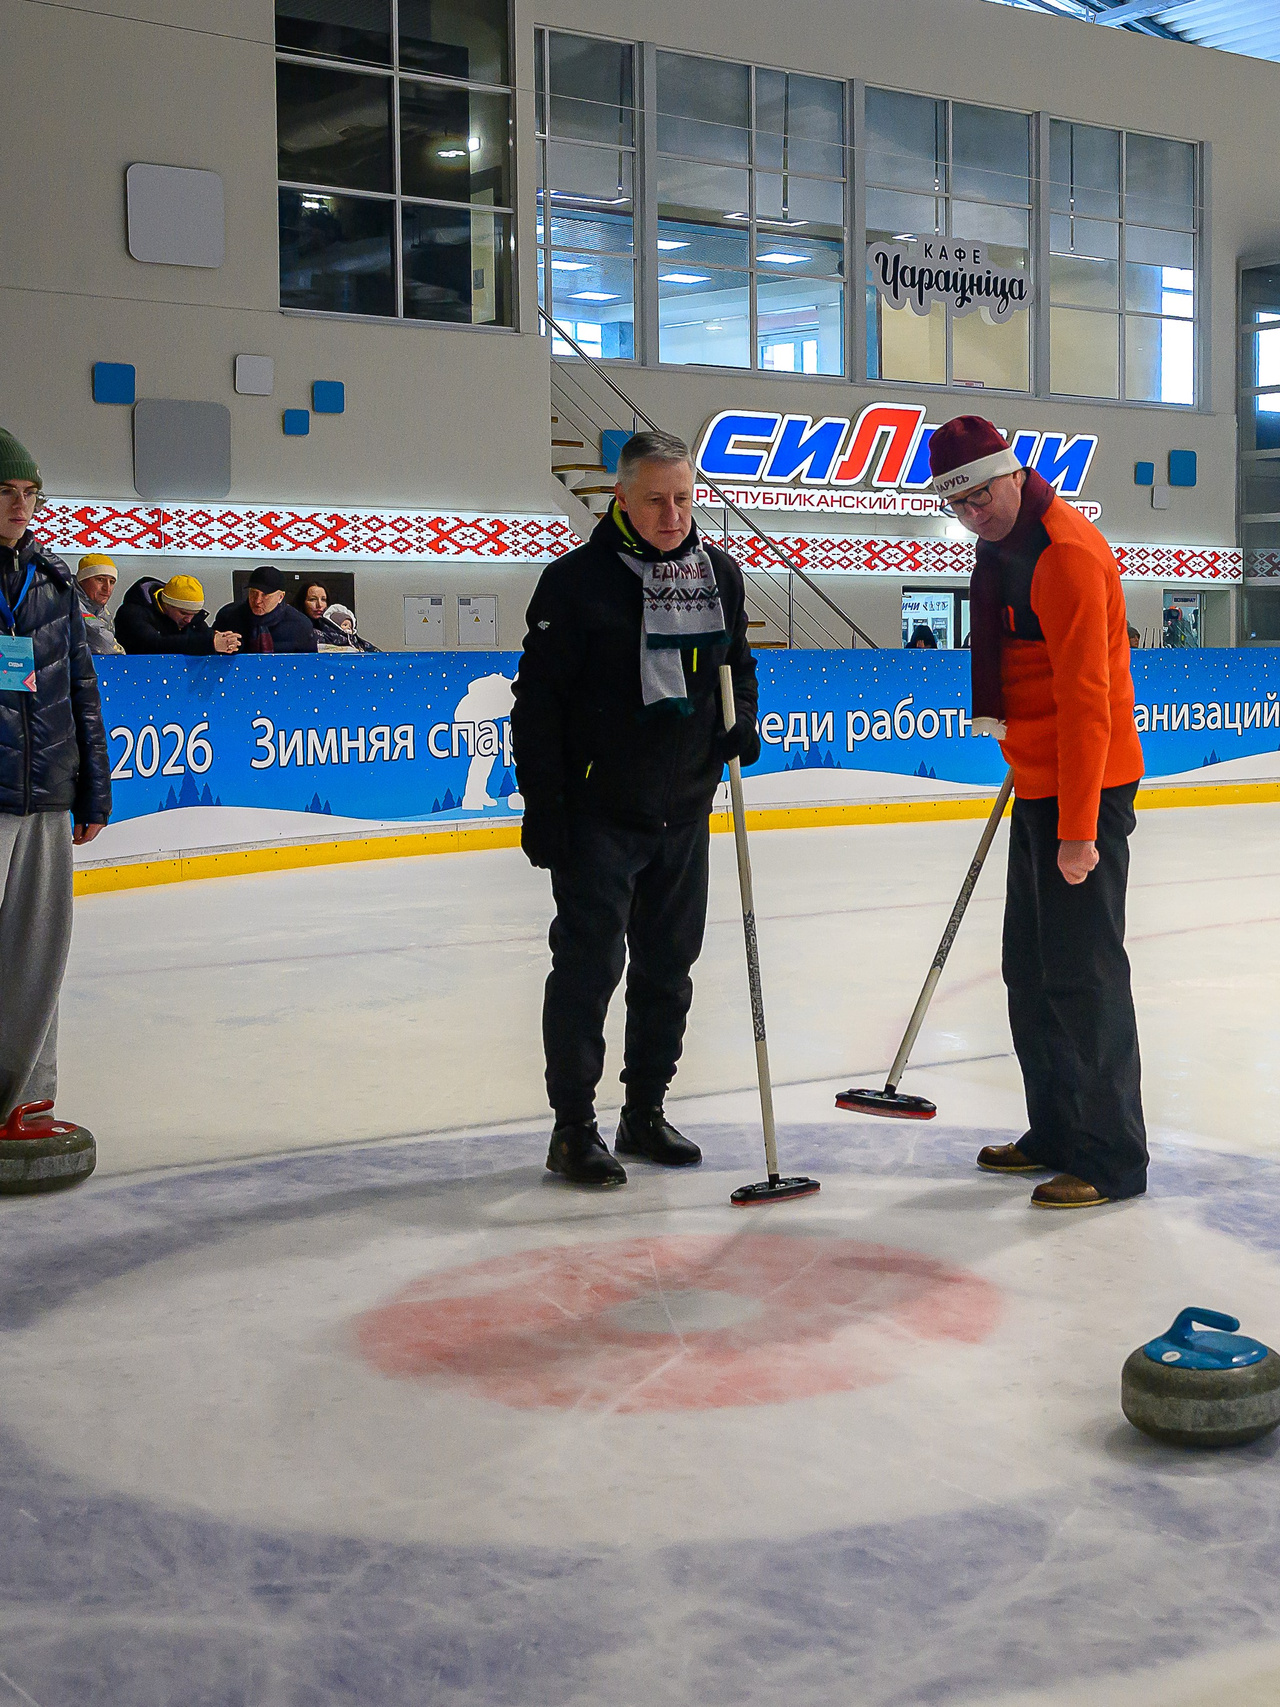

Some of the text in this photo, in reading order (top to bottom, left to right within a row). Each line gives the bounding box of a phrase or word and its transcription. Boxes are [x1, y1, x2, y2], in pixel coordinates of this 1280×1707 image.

[924, 243, 981, 265] КАФЕ
[874, 251, 1028, 315] Чараўніца
[698, 404, 1099, 497] СИЛИ
[695, 488, 898, 510] РЕСПУБЛИКАНСКИЙ
[901, 497, 943, 512] ГОРН
[652, 561, 708, 582] ЕДИНЫЕ
[110, 721, 213, 780] 2026
[250, 716, 416, 770] Зимняя
[427, 719, 514, 767] спар
[754, 711, 834, 752] еди
[846, 697, 973, 752] работн
[1133, 691, 1280, 736] анизаций
